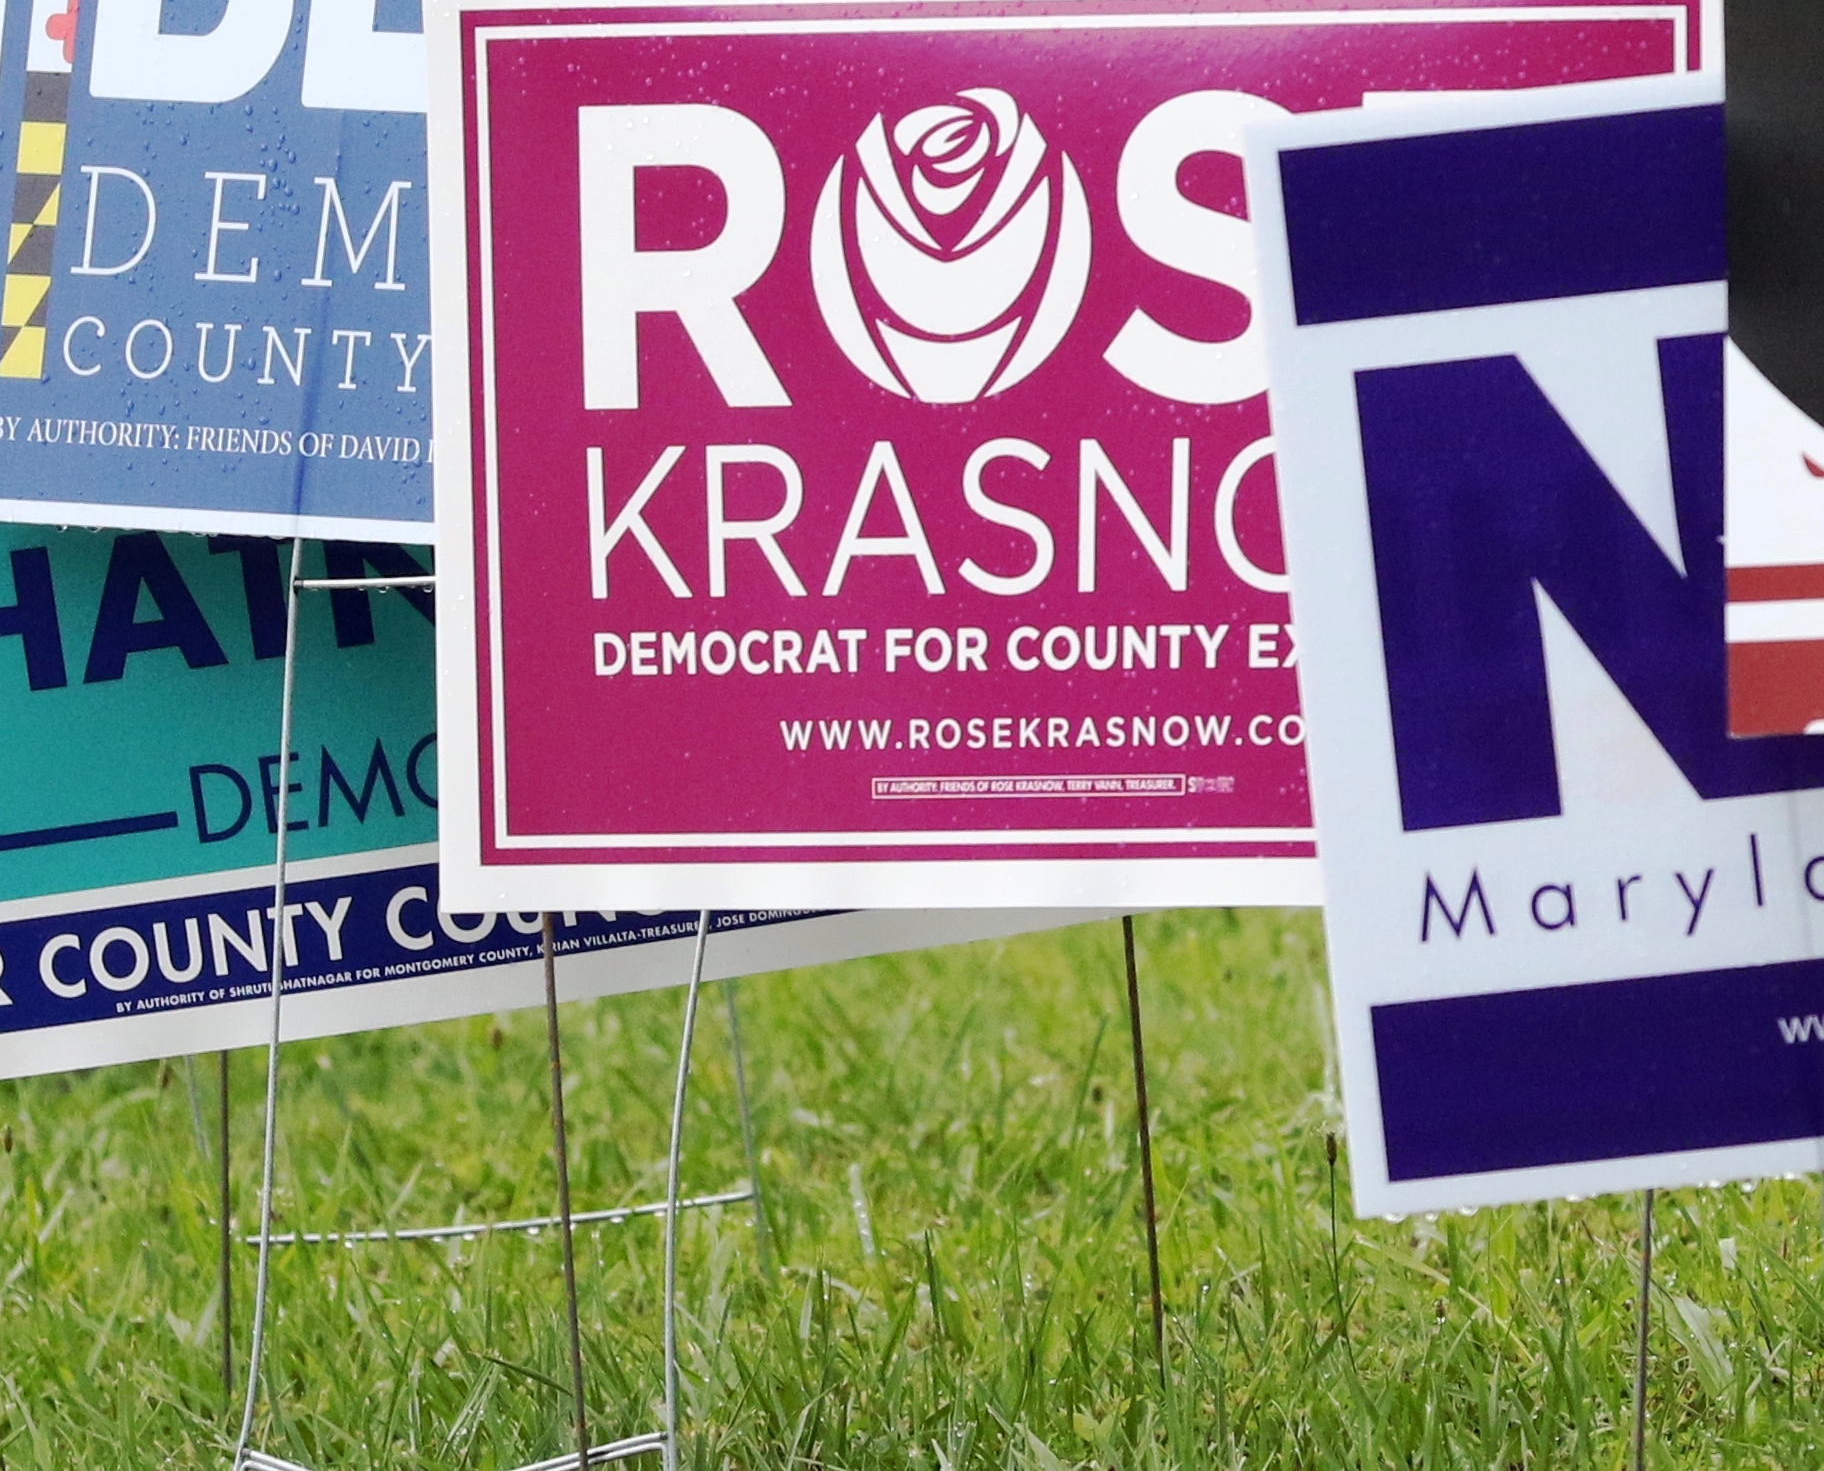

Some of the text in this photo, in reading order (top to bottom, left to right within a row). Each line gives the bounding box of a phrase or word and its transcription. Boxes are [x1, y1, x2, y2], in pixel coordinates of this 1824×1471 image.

[71, 165, 412, 290] DEM
[63, 316, 433, 393] COUNTY
[27, 418, 180, 450] AUTHORITY:
[186, 425, 293, 456] FRIENDS
[298, 431, 334, 459] OF
[338, 434, 422, 463] DAVID
[593, 627, 862, 677] DEMOCRAT
[884, 626, 988, 673] FOR
[1005, 624, 1224, 672] COUNTY
[779, 714, 1307, 751] WWW.ROSEKRASNOW.CO
[991, 780, 1014, 792] ROSE
[39, 896, 354, 1000] COUNTY
[116, 1001, 133, 1014] BY
[136, 990, 206, 1011] AUTHORITY
[209, 988, 227, 1001] OF
[229, 981, 273, 999] SHRUTI
[355, 966, 382, 981] FOR
[384, 952, 476, 979] MONTGOMERY
[479, 944, 534, 965] COUNTY,
[536, 938, 581, 956] KRIAN
[715, 912, 746, 928] JOSE
[749, 908, 821, 923] DOMIN
